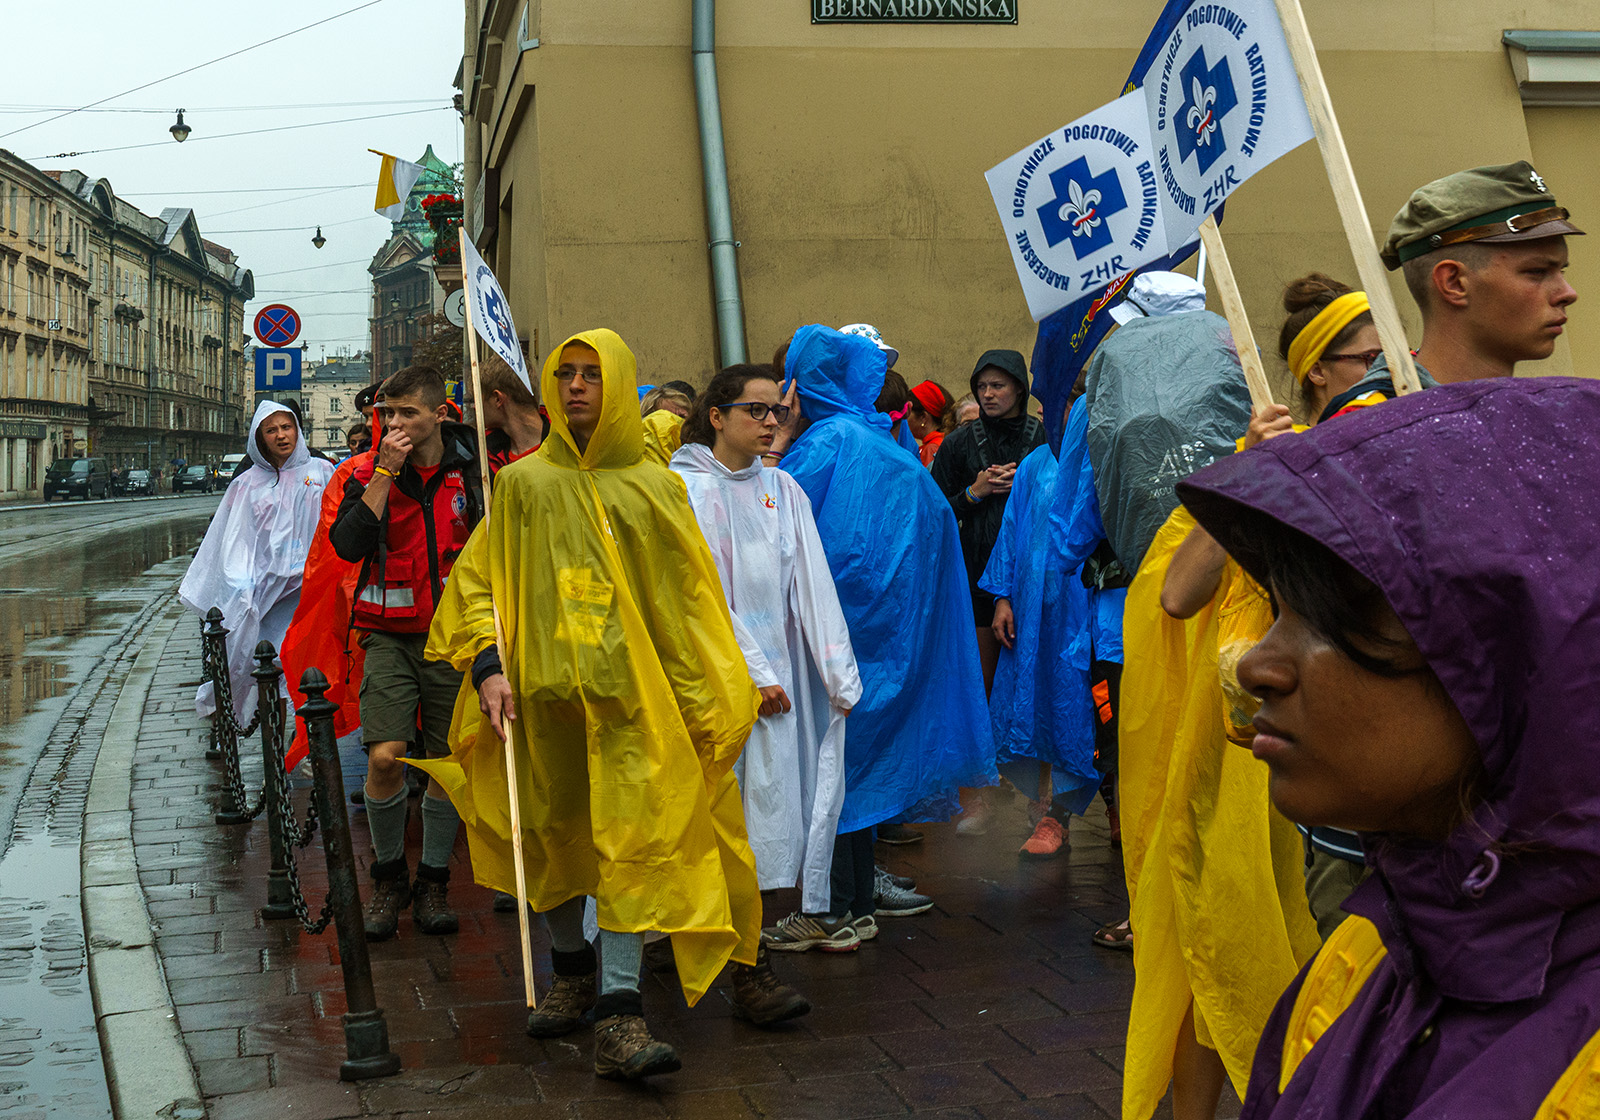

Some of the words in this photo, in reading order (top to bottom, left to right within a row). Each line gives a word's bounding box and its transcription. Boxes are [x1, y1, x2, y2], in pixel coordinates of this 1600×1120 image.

[1187, 5, 1248, 41] POGOTOWIE
[1158, 29, 1183, 131] OCHOTNICZE
[1240, 42, 1267, 158] RATUNKOWE
[1064, 124, 1139, 158] POGOTOWIE
[1013, 138, 1056, 218] OCHOTNICZE
[1130, 160, 1157, 251] RATUNKOWE
[1159, 144, 1196, 215] HARCERSKIE
[1203, 165, 1241, 214] ZHR
[1015, 229, 1070, 291] HARCERSKIE
[1080, 255, 1131, 291] ZHR
[266, 353, 292, 386] P
